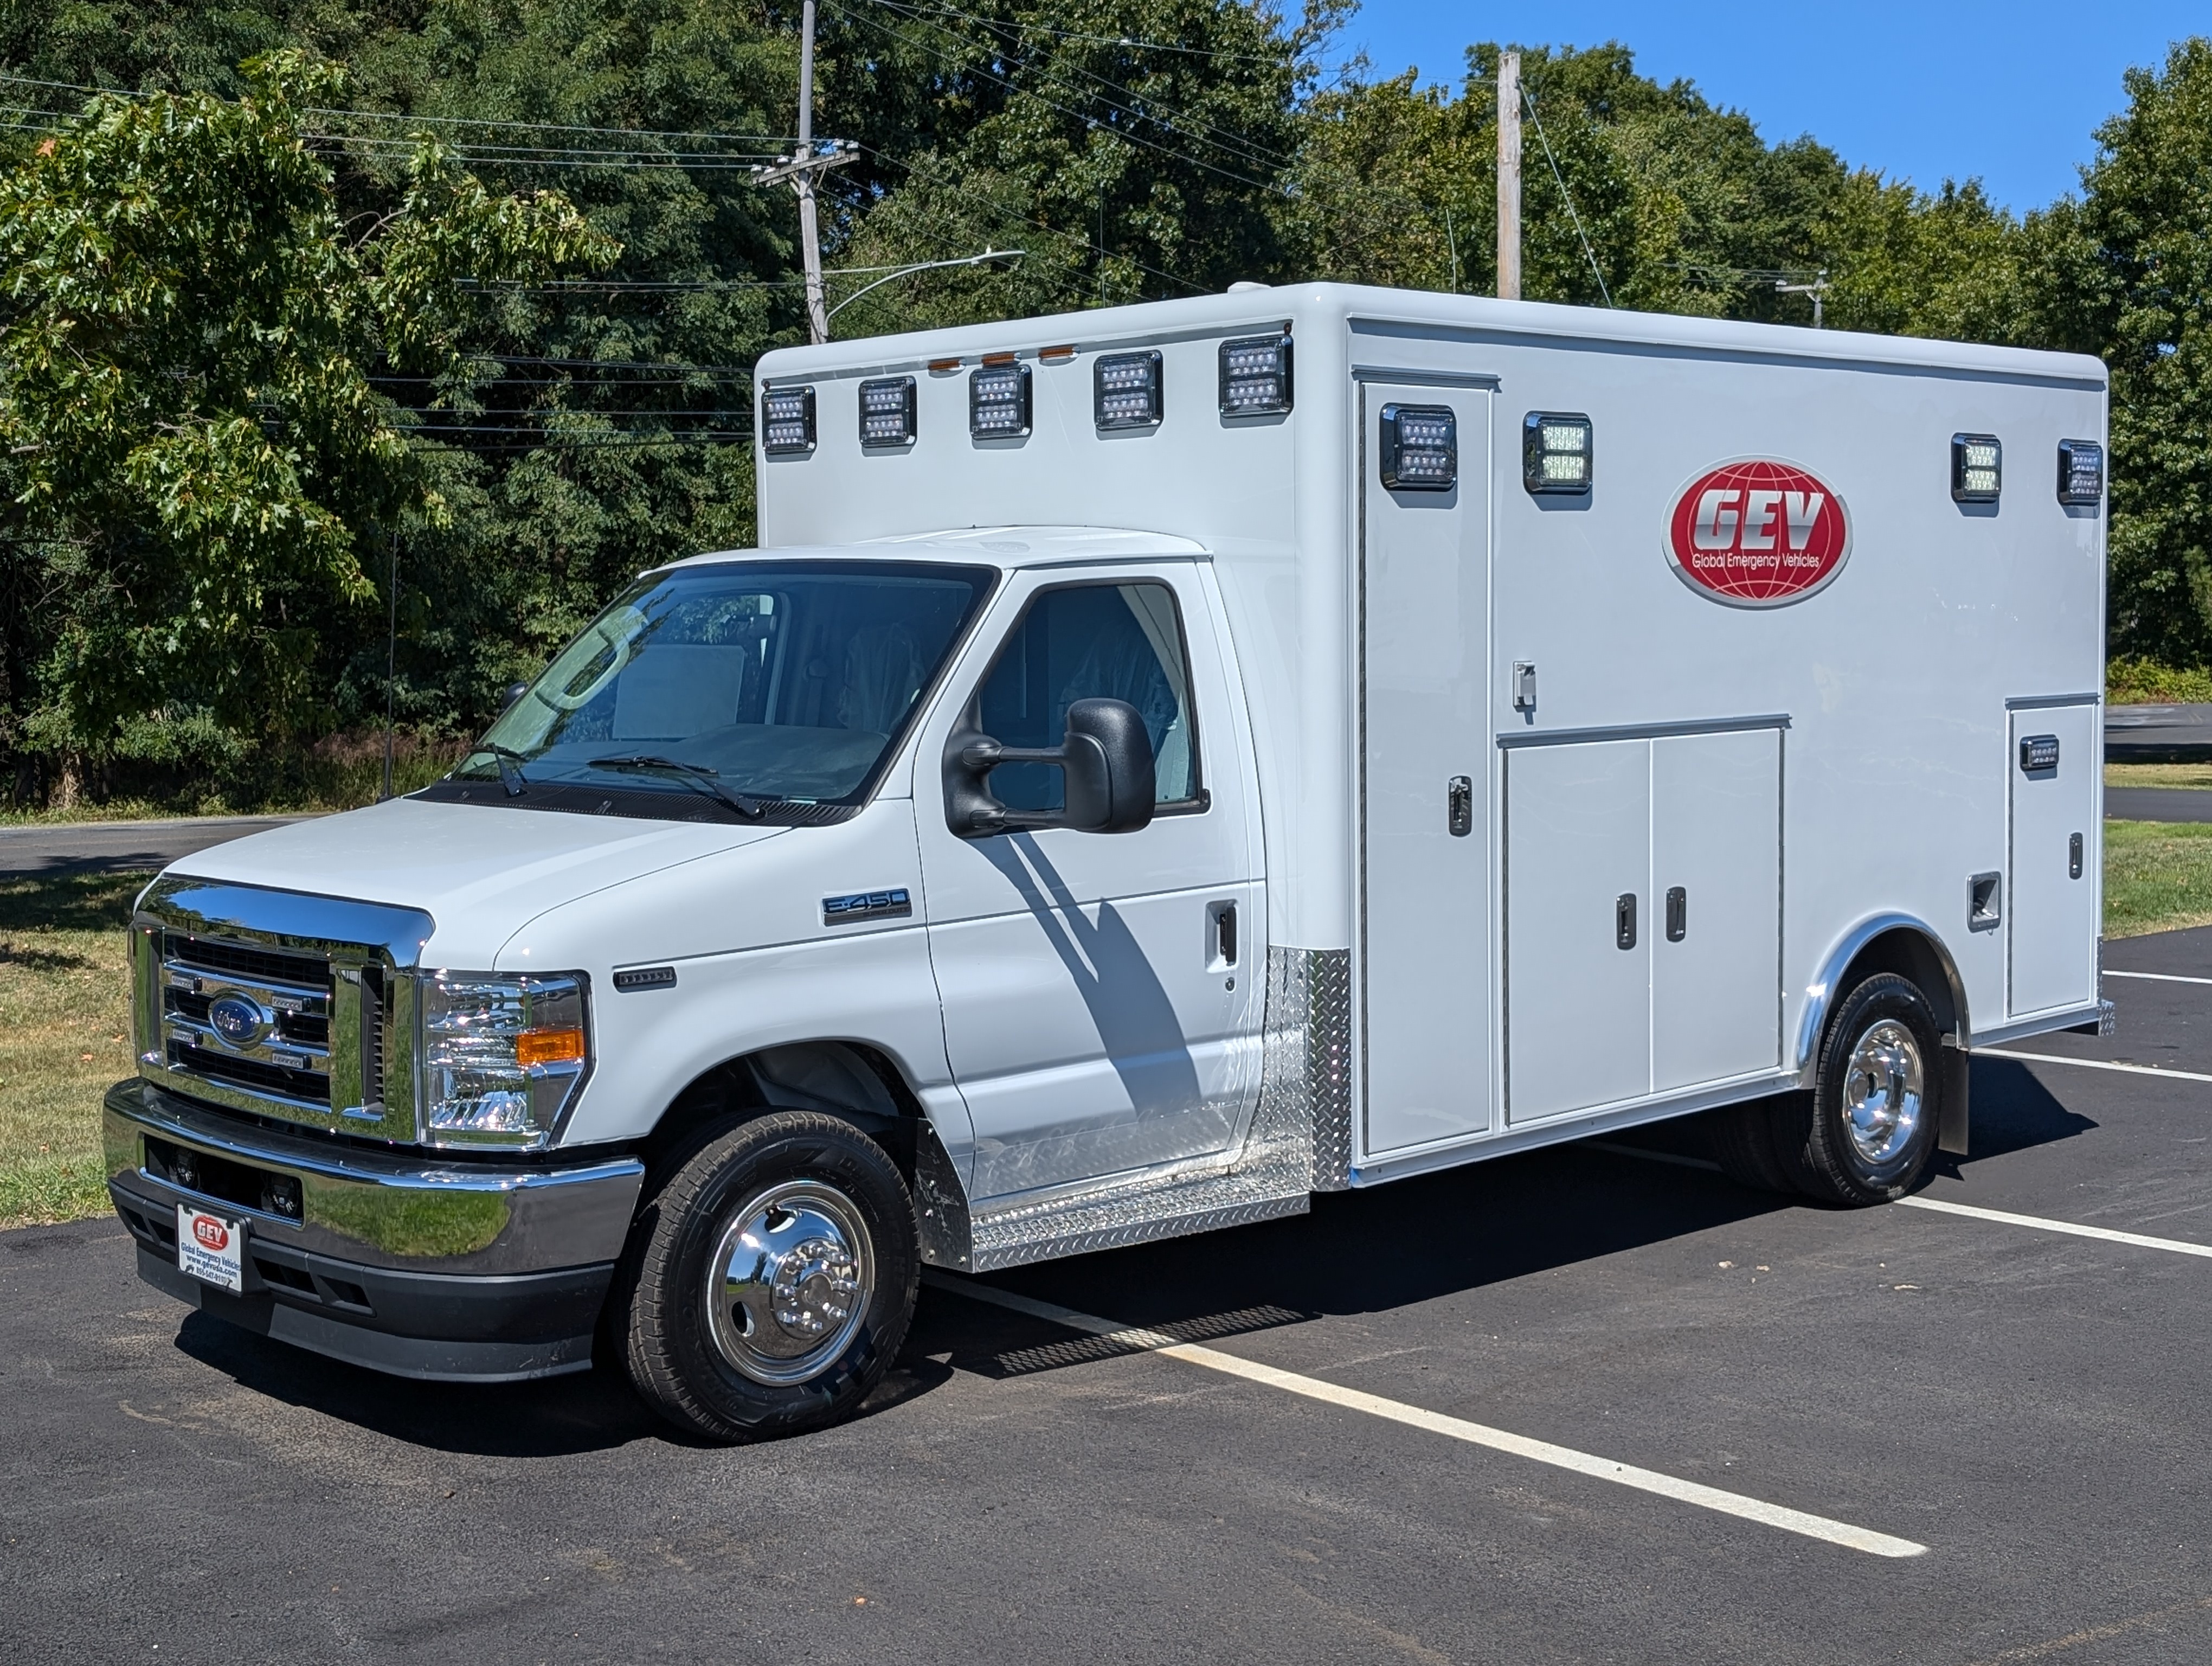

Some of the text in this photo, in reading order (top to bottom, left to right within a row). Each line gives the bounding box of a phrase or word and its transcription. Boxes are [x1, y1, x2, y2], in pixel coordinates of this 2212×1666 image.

[1694, 489, 1824, 550] GEV
[1692, 553, 1819, 570] Global Emergency Vehicles
[824, 890, 910, 913] E-450
[197, 1221, 222, 1243] GEV
[181, 1242, 195, 1254] Global
[196, 1247, 221, 1267] Emergency
